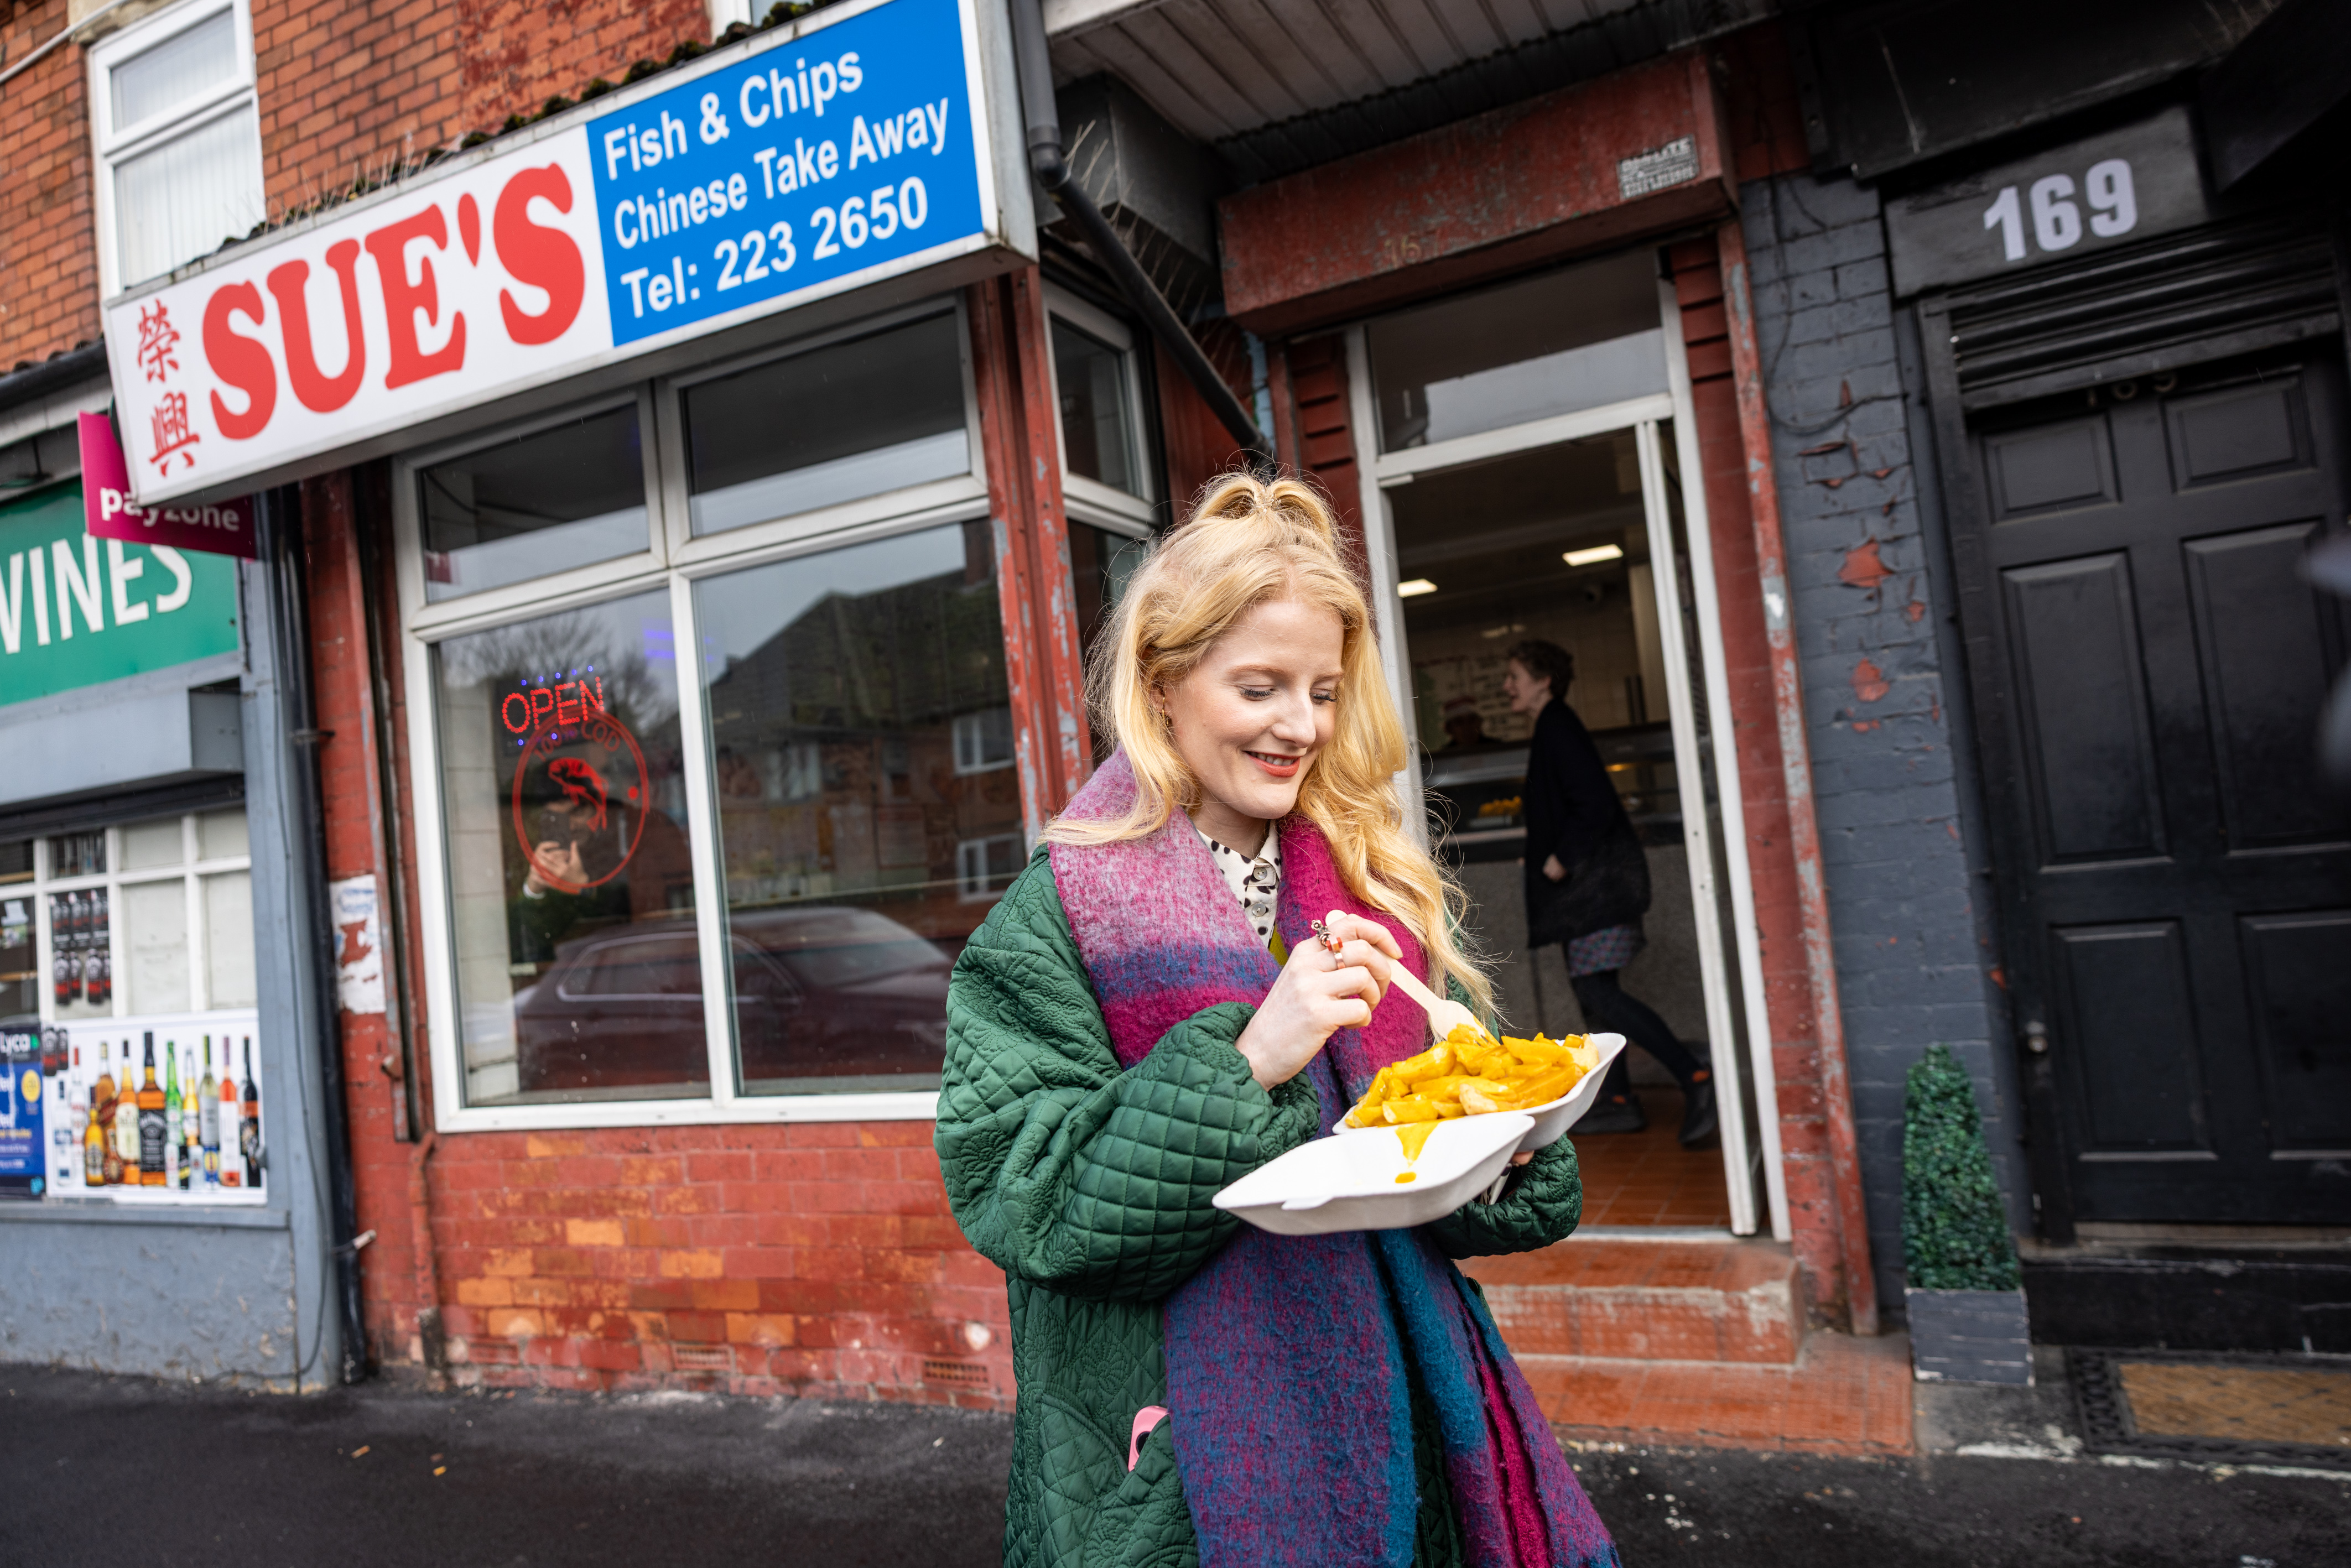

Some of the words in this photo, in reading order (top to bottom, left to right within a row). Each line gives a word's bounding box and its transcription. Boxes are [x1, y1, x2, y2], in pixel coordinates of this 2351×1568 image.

[604, 110, 688, 181] Fish
[699, 92, 730, 145] &
[740, 52, 863, 128] Chips
[614, 172, 747, 249] Chinese
[753, 137, 839, 199] Take
[849, 97, 949, 170] Away
[621, 256, 700, 318] Tel:
[714, 221, 797, 291] 223
[810, 176, 928, 261] 2650
[1983, 158, 2138, 262] 169
[202, 161, 586, 440] SUE'S
[502, 676, 605, 734] OPEN
[581, 720, 621, 752] COD
[0, 1031, 31, 1056] Lyca
